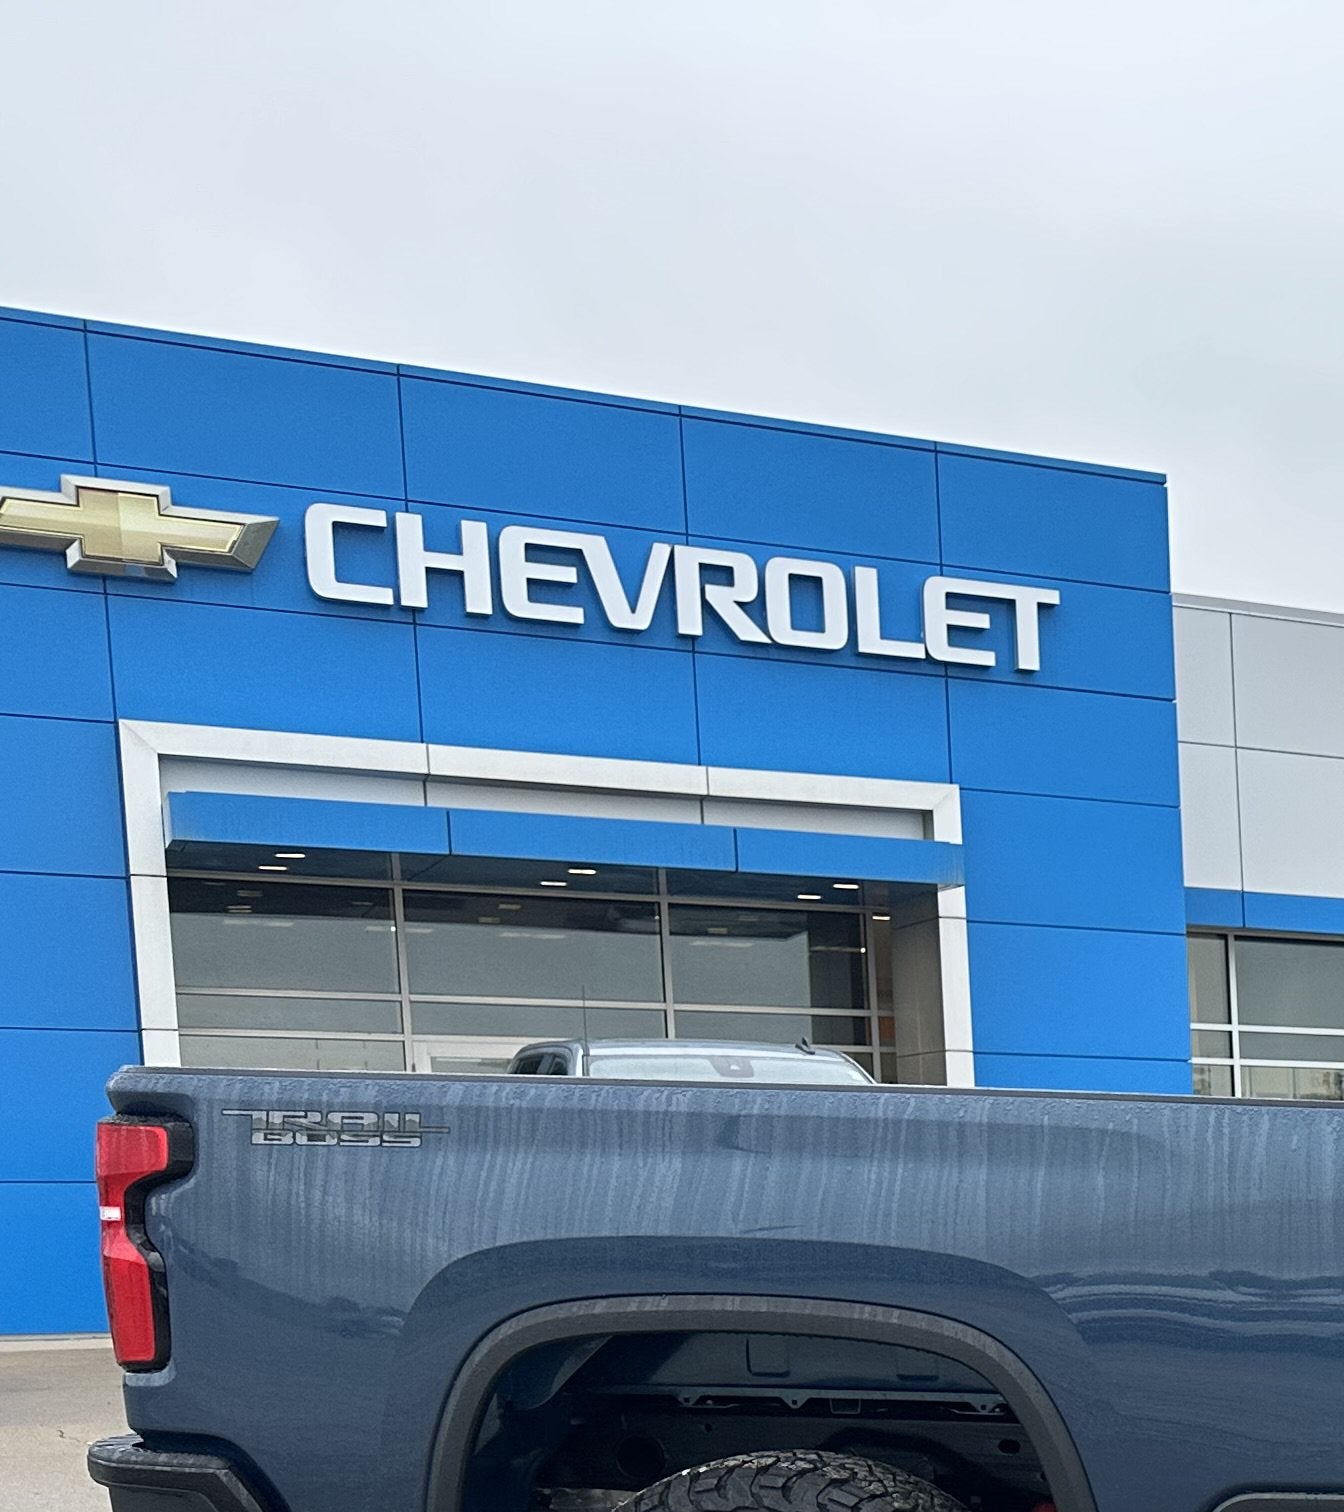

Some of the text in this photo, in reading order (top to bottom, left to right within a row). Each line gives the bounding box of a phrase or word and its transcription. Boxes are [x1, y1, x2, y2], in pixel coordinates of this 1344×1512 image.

[305, 502, 1061, 672] CHEVROLET
[221, 1108, 450, 1133] TRAIL
[250, 1129, 422, 1147] BOSS
